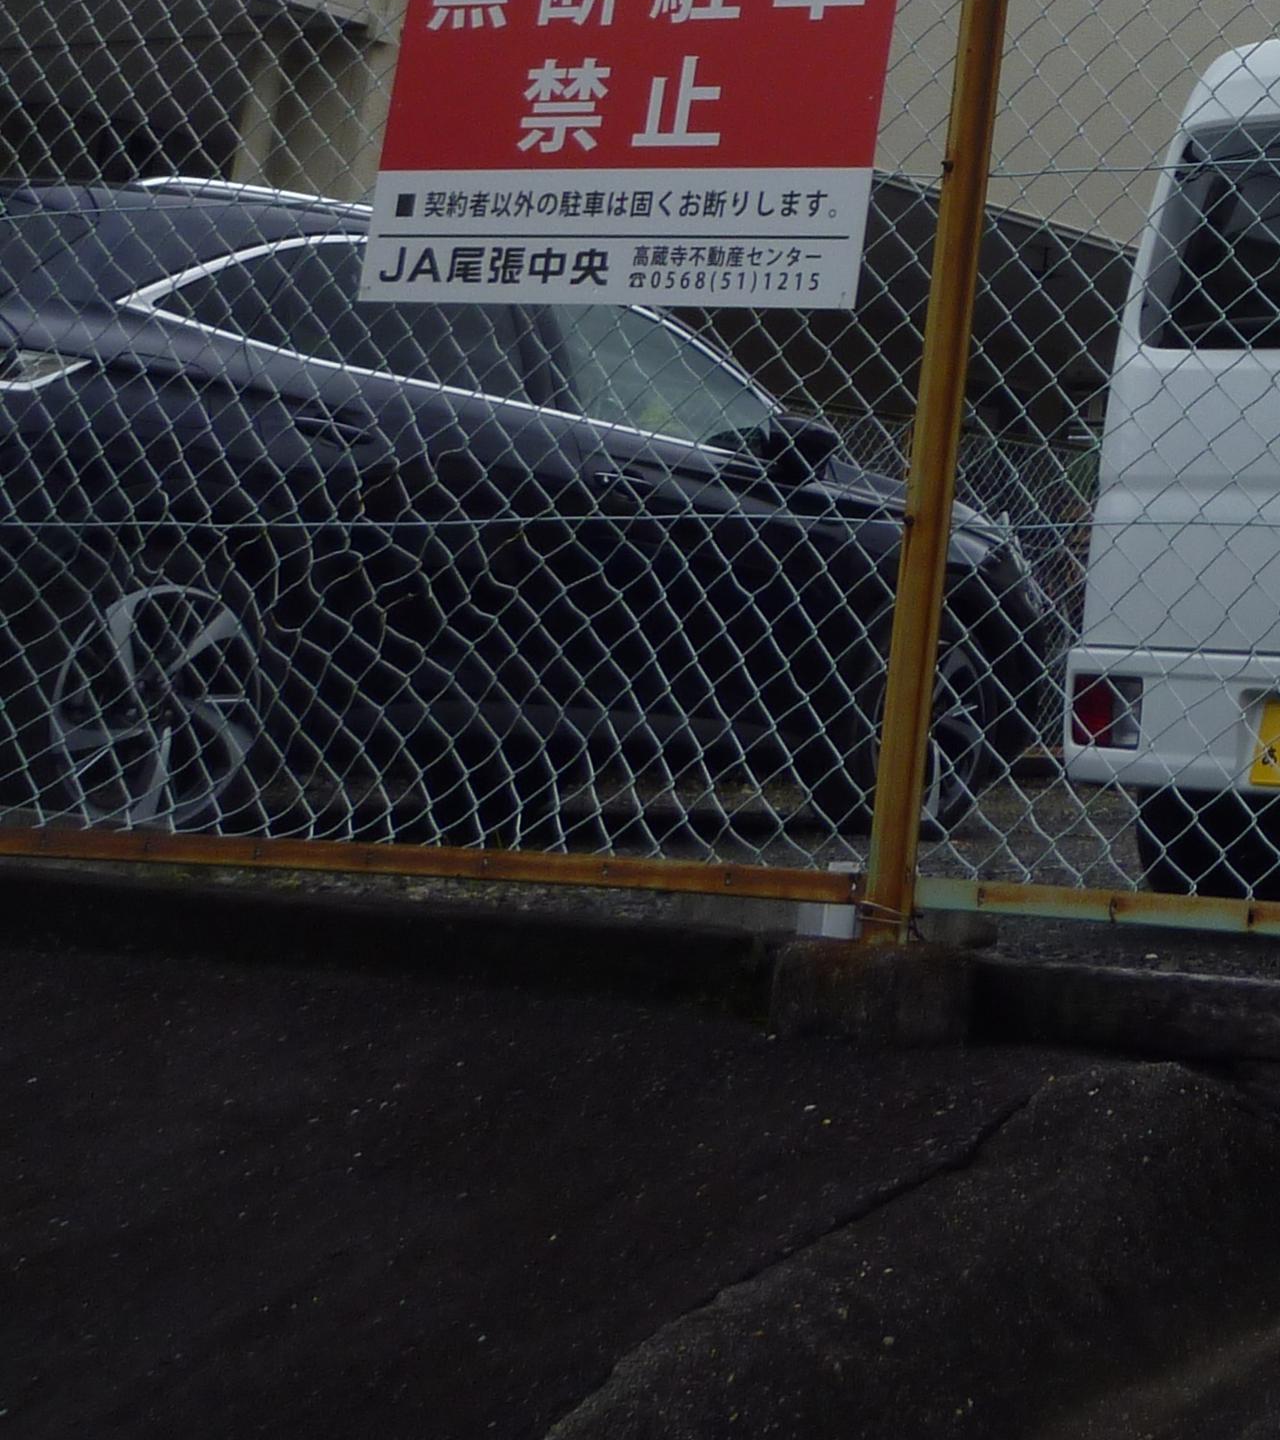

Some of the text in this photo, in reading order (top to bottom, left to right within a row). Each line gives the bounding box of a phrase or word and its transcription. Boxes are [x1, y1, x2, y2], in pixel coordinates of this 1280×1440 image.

[517, 55, 722, 153] 禁止
[379, 246, 609, 287] JA尾張中央
